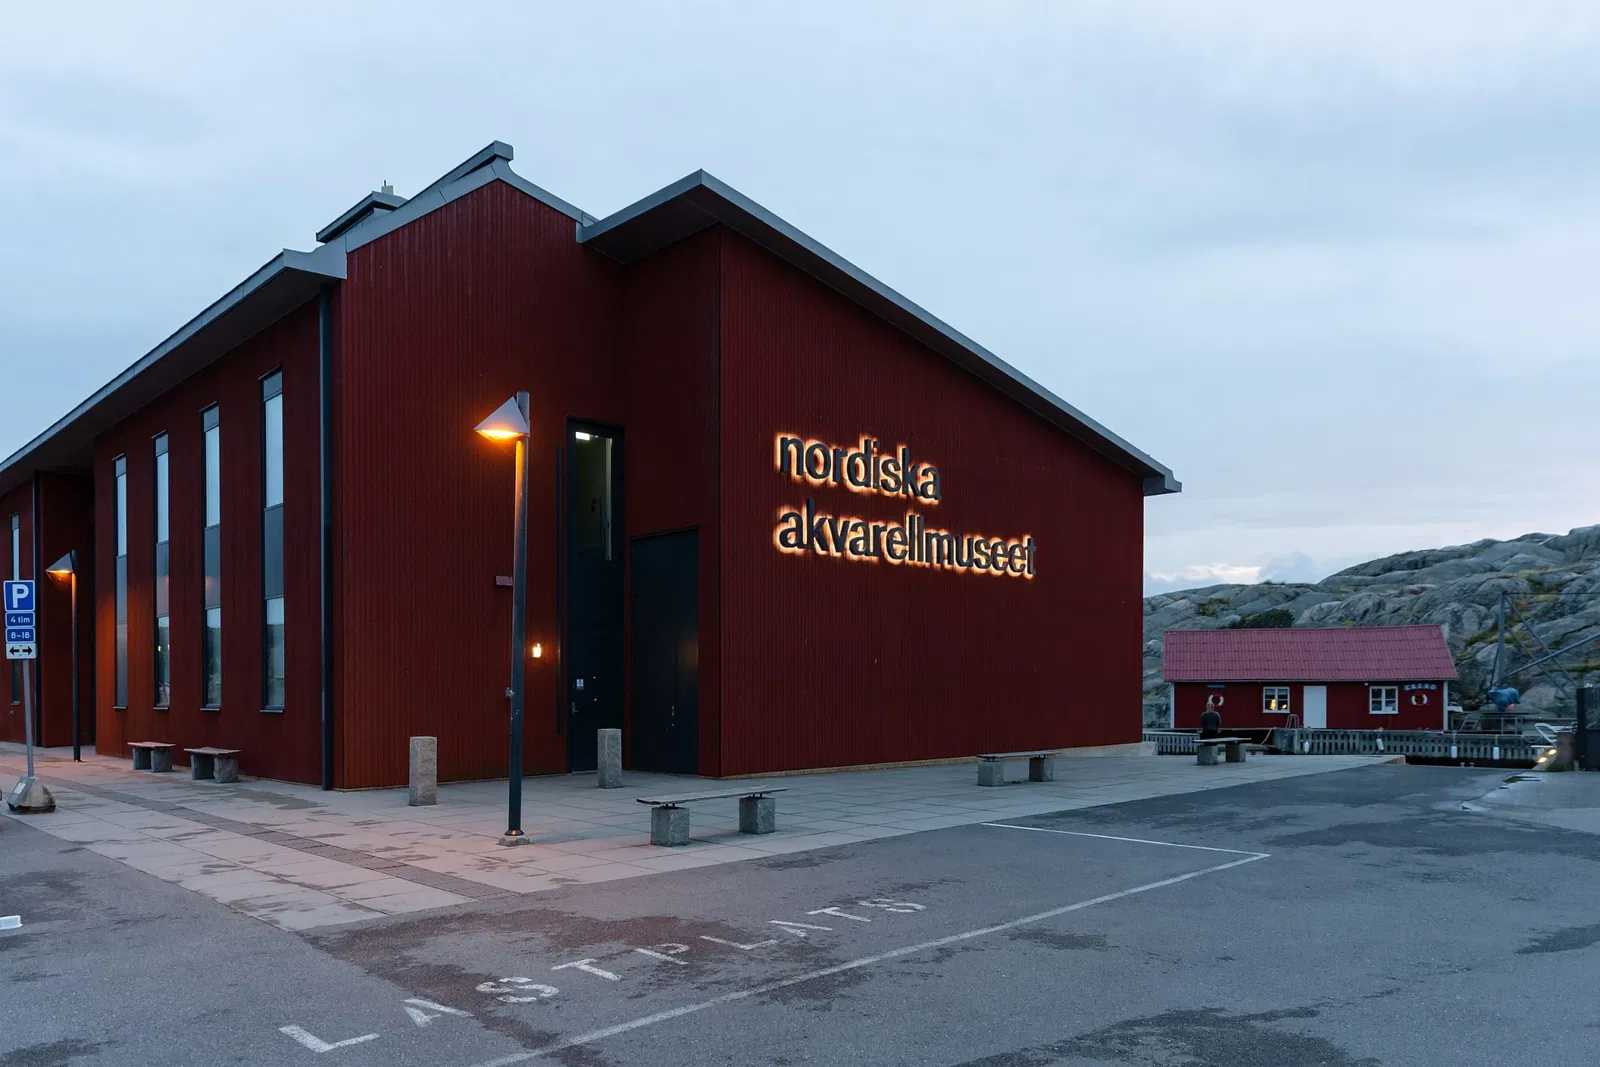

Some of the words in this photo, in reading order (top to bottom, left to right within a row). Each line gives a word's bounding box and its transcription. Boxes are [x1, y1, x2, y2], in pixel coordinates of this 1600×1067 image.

[777, 435, 943, 501] nordiska
[777, 498, 1038, 576] akvarellmuseet
[12, 584, 29, 608] P
[10, 631, 30, 639] 8-18
